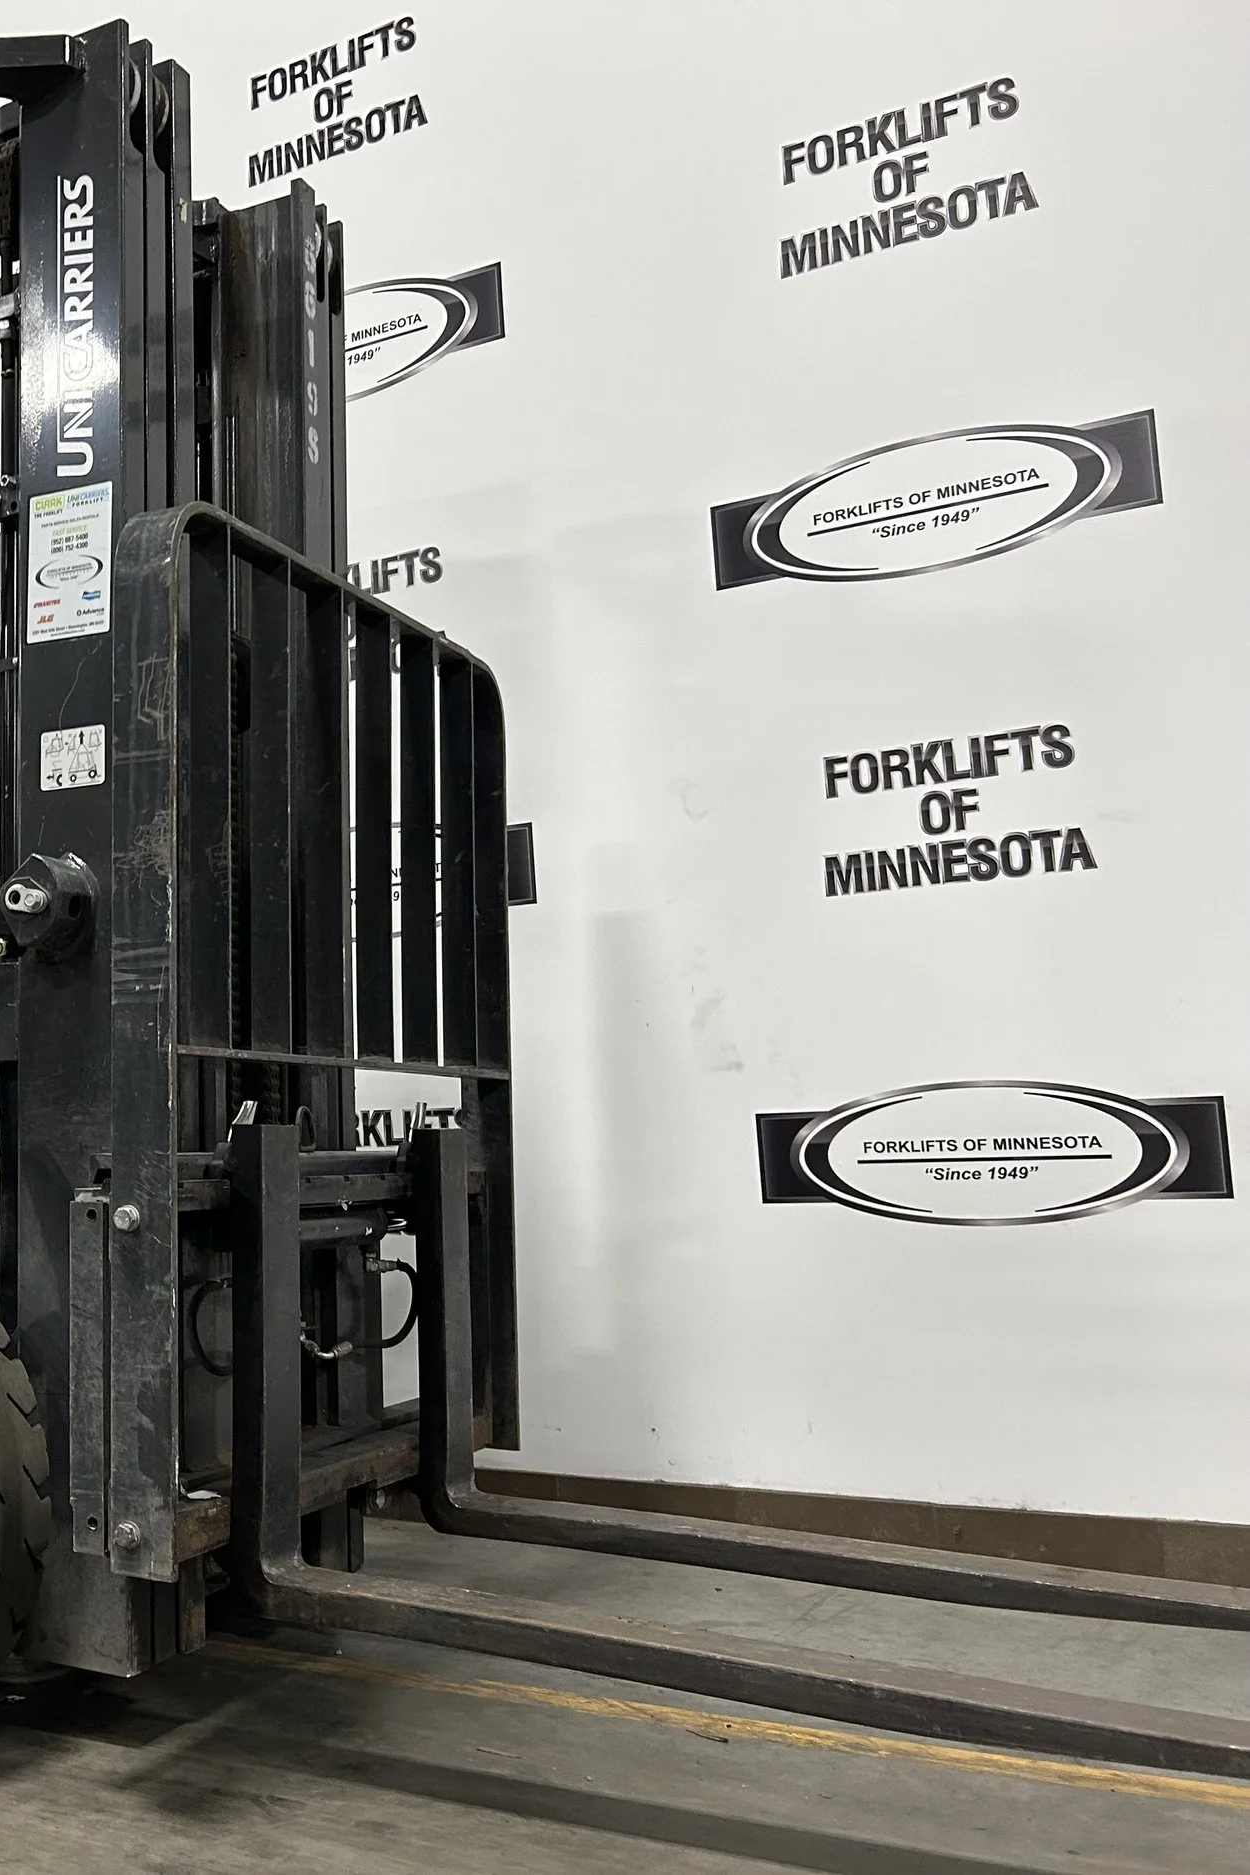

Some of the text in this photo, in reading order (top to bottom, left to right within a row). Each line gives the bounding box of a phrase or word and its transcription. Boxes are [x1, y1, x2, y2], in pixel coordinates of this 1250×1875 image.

[250, 16, 417, 111] FORKLIFTS
[313, 79, 354, 124] OF
[248, 94, 429, 188] MINNESOTA
[781, 77, 1020, 186] FORKLIFTS
[871, 151, 931, 203] OF
[779, 170, 1040, 280] MINNESOTA
[56, 174, 95, 477] UNICARRIERS
[351, 313, 423, 343] MINNESOTA
[35, 496, 63, 511] CLARK
[813, 467, 1040, 526] FORKLIFTS OF MINNESOTA
[82, 607, 105, 615] Advance
[823, 723, 1076, 799] FORKLIFTS
[919, 787, 980, 836] OF
[823, 827, 1099, 898] MINNESOTA
[863, 1135, 1103, 1154] FORKLIFTS OF MINNESOTA
